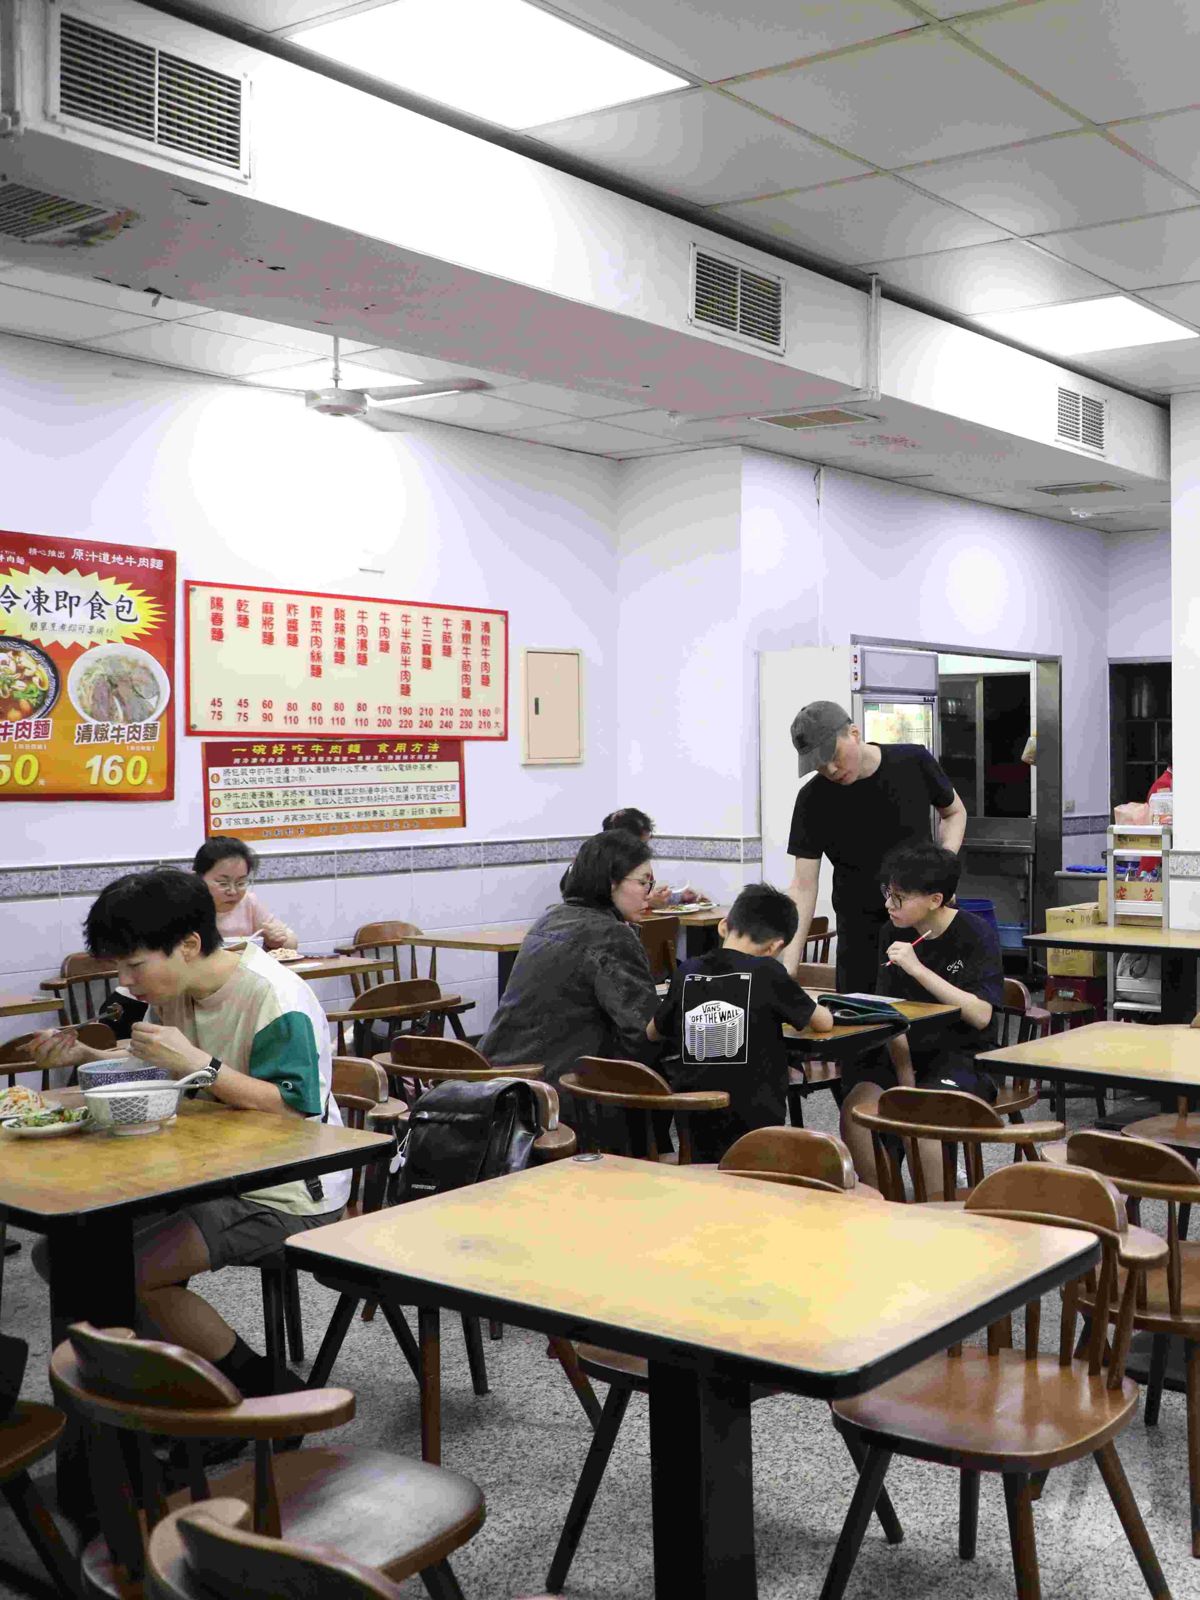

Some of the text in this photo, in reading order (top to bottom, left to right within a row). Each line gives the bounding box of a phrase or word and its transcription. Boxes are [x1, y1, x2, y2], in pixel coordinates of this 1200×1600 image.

[71, 549, 164, 570] 原汁道地牛肉麵
[210, 596, 224, 642] 陽春麵
[236, 599, 250, 628] 乾麵
[286, 604, 298, 647] 炸醬麵
[334, 608, 345, 665] 酸辣湯麵
[357, 610, 368, 666] 牛肉湯麵
[379, 612, 390, 653] 牛肉麵
[422, 616, 432, 670] 牛三寶麵
[442, 618, 452, 658] 牛筋麵
[480, 621, 491, 687] 清燉牛肉麵
[210, 698, 222, 707] 45
[237, 698, 249, 708] 45
[262, 700, 273, 709] 60
[287, 702, 298, 712] 80
[311, 702, 322, 711] 80
[334, 702, 344, 712] 80
[357, 702, 367, 712] 80
[378, 706, 391, 715] 170
[399, 706, 413, 716] 190
[419, 707, 433, 716] 210
[440, 707, 454, 716] 210
[460, 709, 473, 717] 200
[211, 711, 223, 720] 75
[238, 712, 249, 722] 75
[262, 713, 273, 722] 90
[284, 716, 299, 724] 110
[308, 716, 323, 725] 110
[330, 717, 345, 726] 110
[354, 718, 369, 727] 110
[377, 718, 392, 727] 200
[399, 720, 413, 728] 220
[419, 720, 433, 728] 240
[440, 720, 453, 729] 240
[460, 721, 473, 729] 230
[478, 721, 491, 729] 210
[0, 720, 51, 741] 牛肉麵
[75, 723, 159, 744] 清燉牛肉麵
[232, 742, 440, 754] 一碗好吃牛肉麵 食用方法
[86, 754, 148, 786] 160
[705, 1014, 717, 1023] THE
